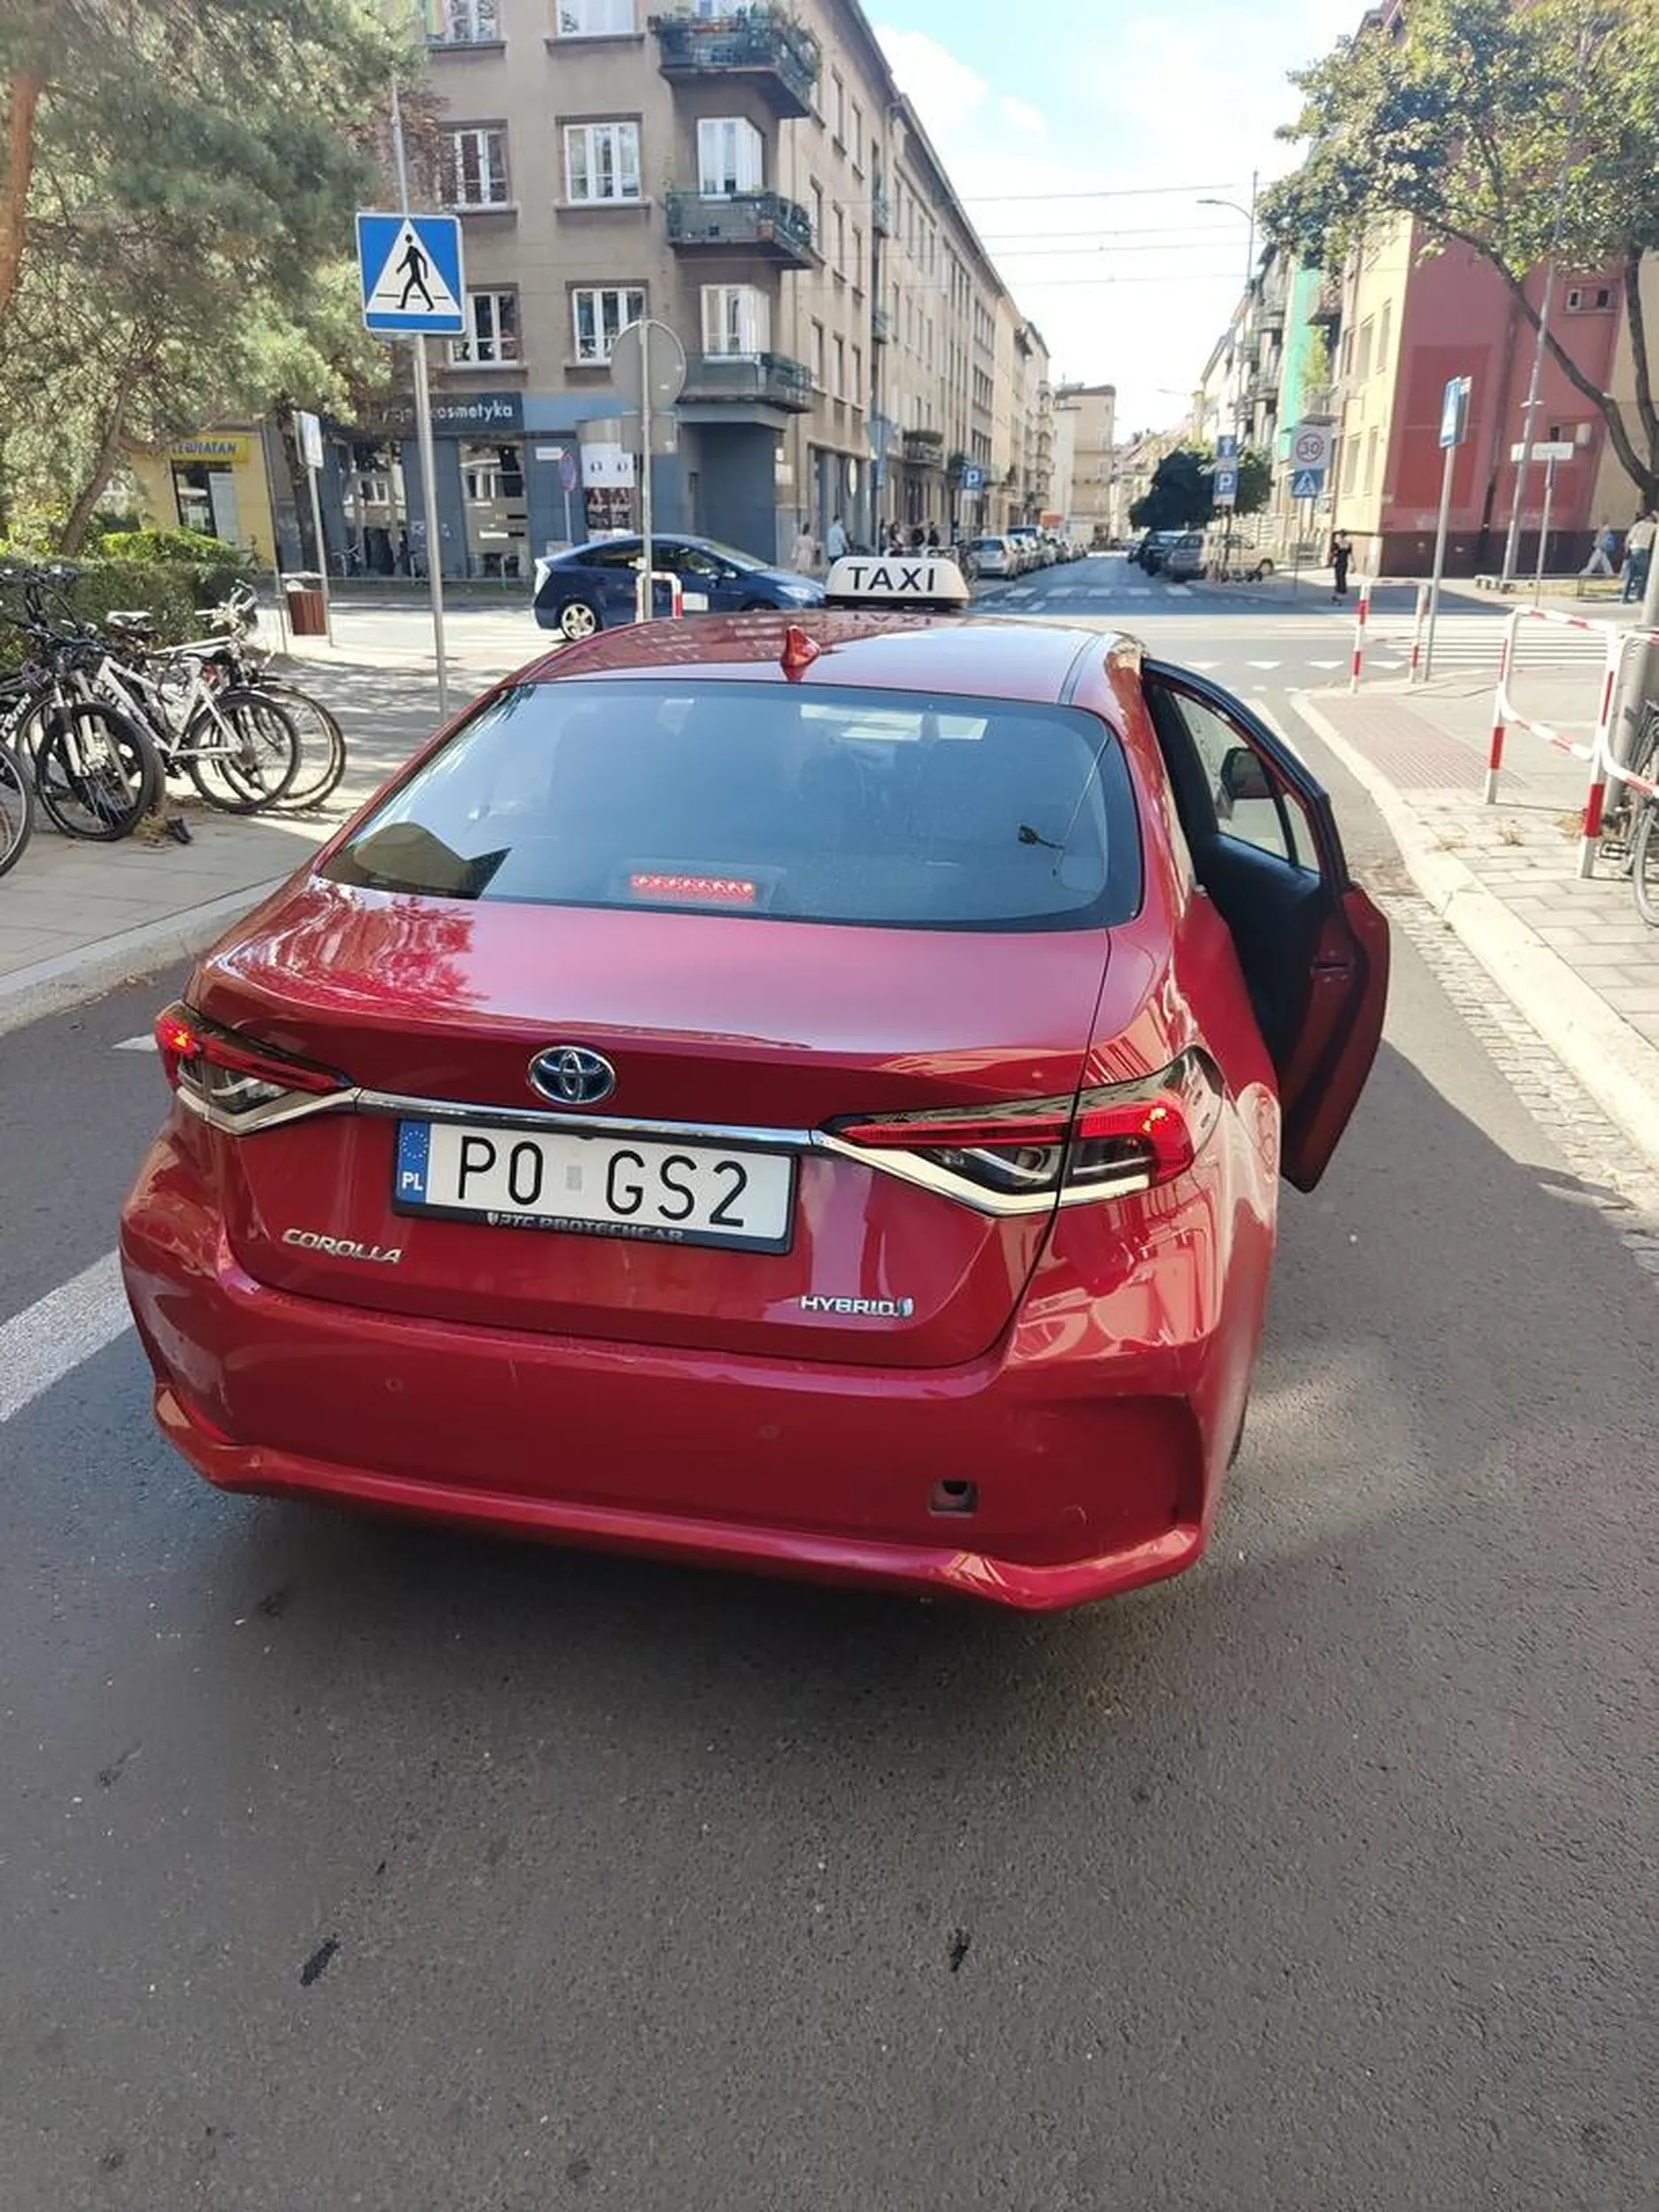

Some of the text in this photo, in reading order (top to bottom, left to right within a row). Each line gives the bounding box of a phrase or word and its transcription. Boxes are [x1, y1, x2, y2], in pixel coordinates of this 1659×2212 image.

[1300, 442, 1320, 453] 30
[966, 471, 979, 488] P
[1218, 472, 1233, 492] P
[848, 566, 935, 592] TAXI
[402, 1171, 424, 1192] PL
[606, 1149, 748, 1227] GS2
[282, 1228, 403, 1264] COROLLA
[800, 1295, 895, 1317] HYBRID
